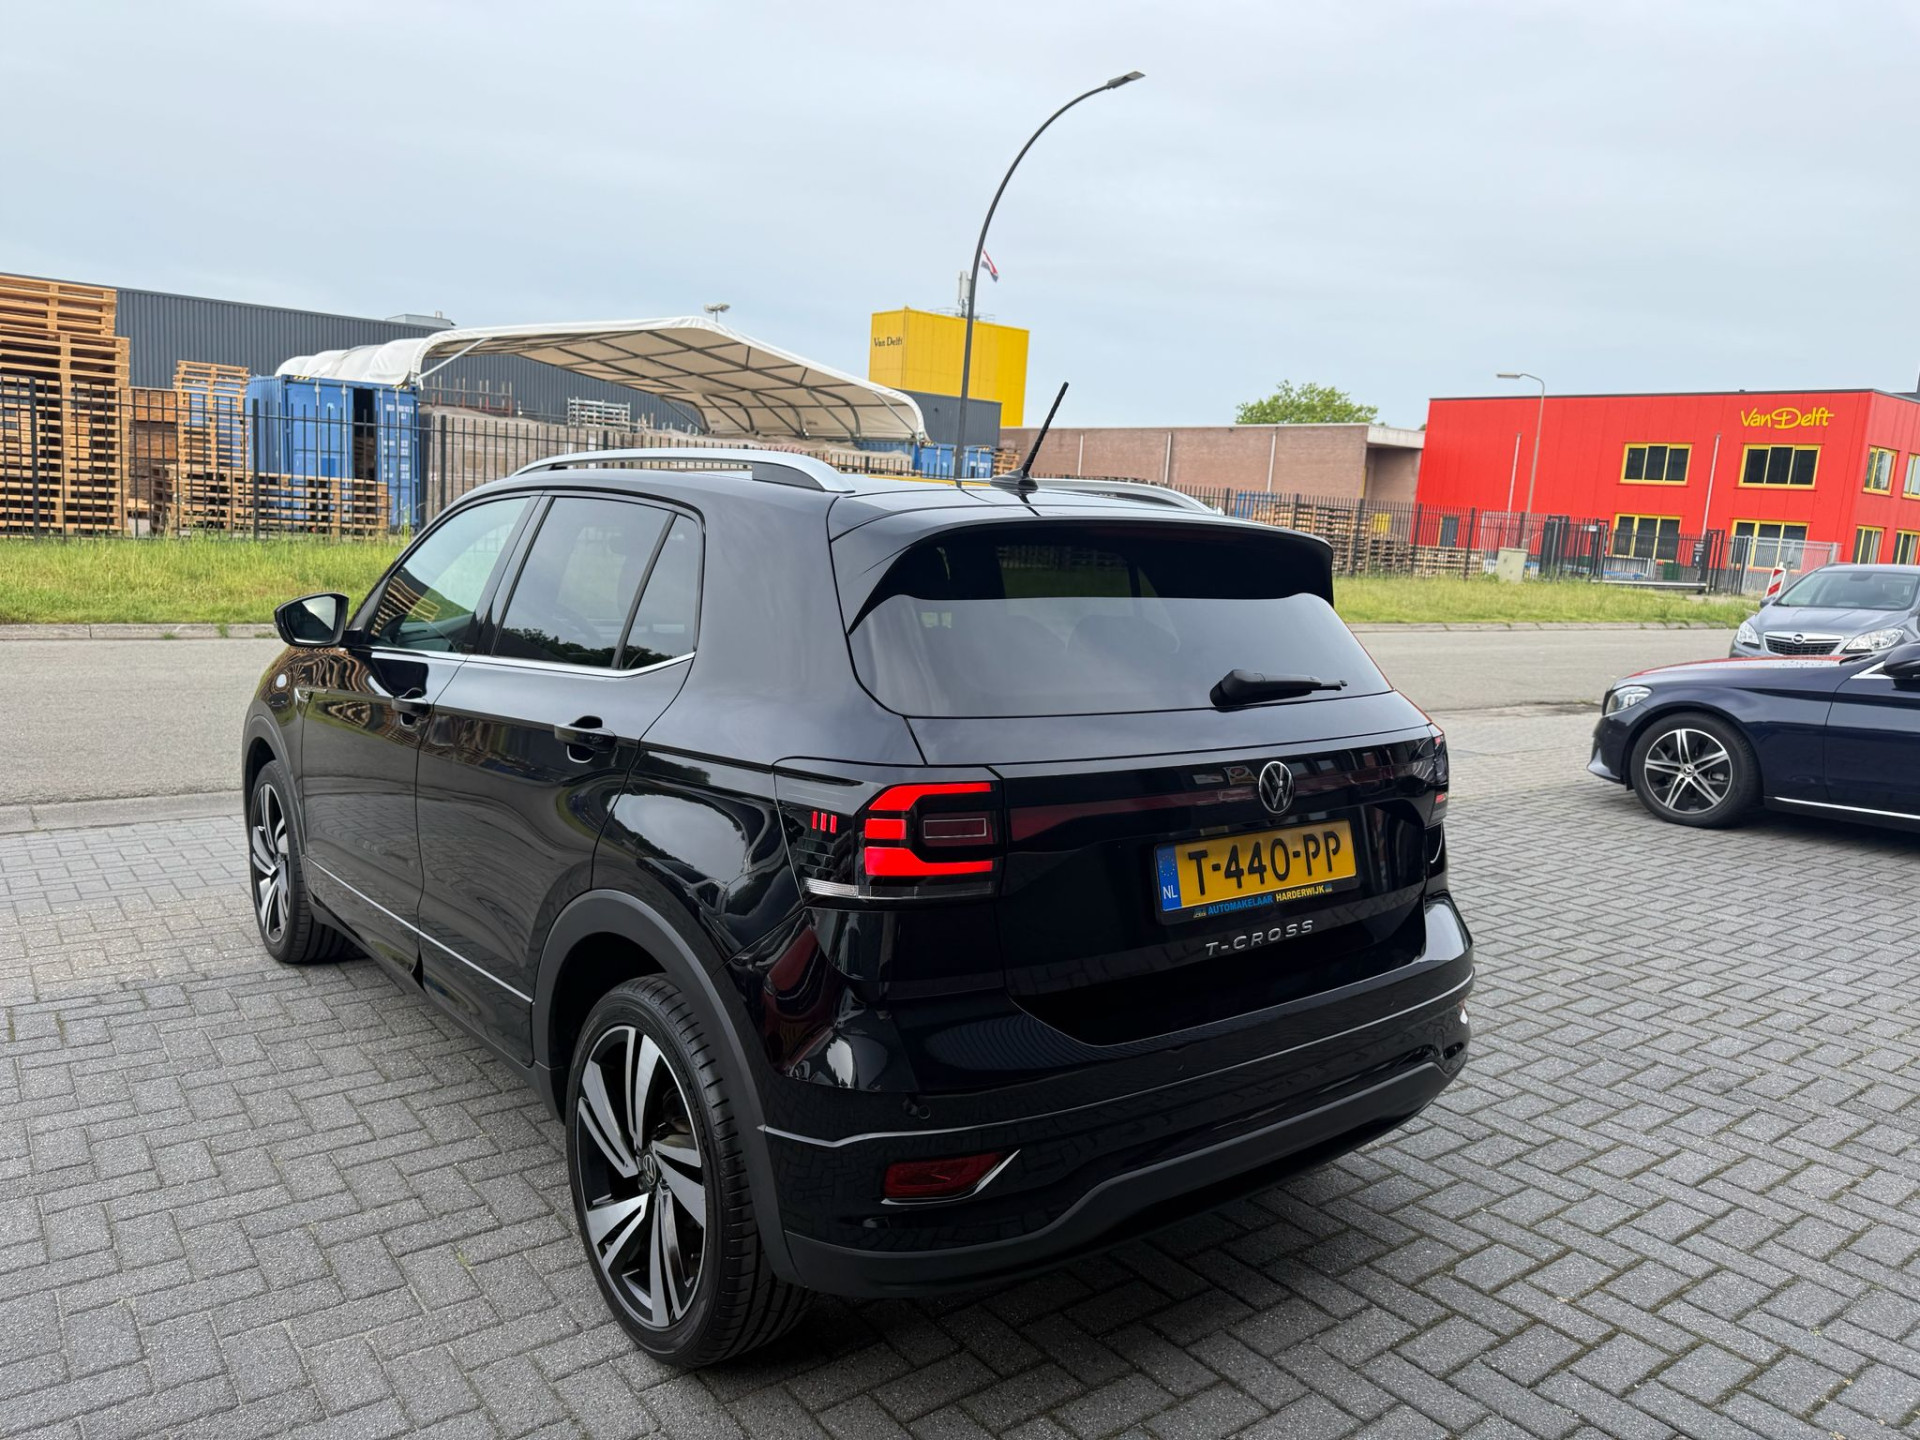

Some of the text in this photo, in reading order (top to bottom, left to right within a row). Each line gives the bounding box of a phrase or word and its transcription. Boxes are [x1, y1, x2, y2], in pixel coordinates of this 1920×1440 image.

[873, 337, 885, 347] Van
[1187, 832, 1341, 896] T-440-PP
[1162, 885, 1178, 900] NL
[1207, 885, 1325, 915] AUTOMAKELAAR HARDERWIJK
[1206, 920, 1313, 956] T-CROSS
